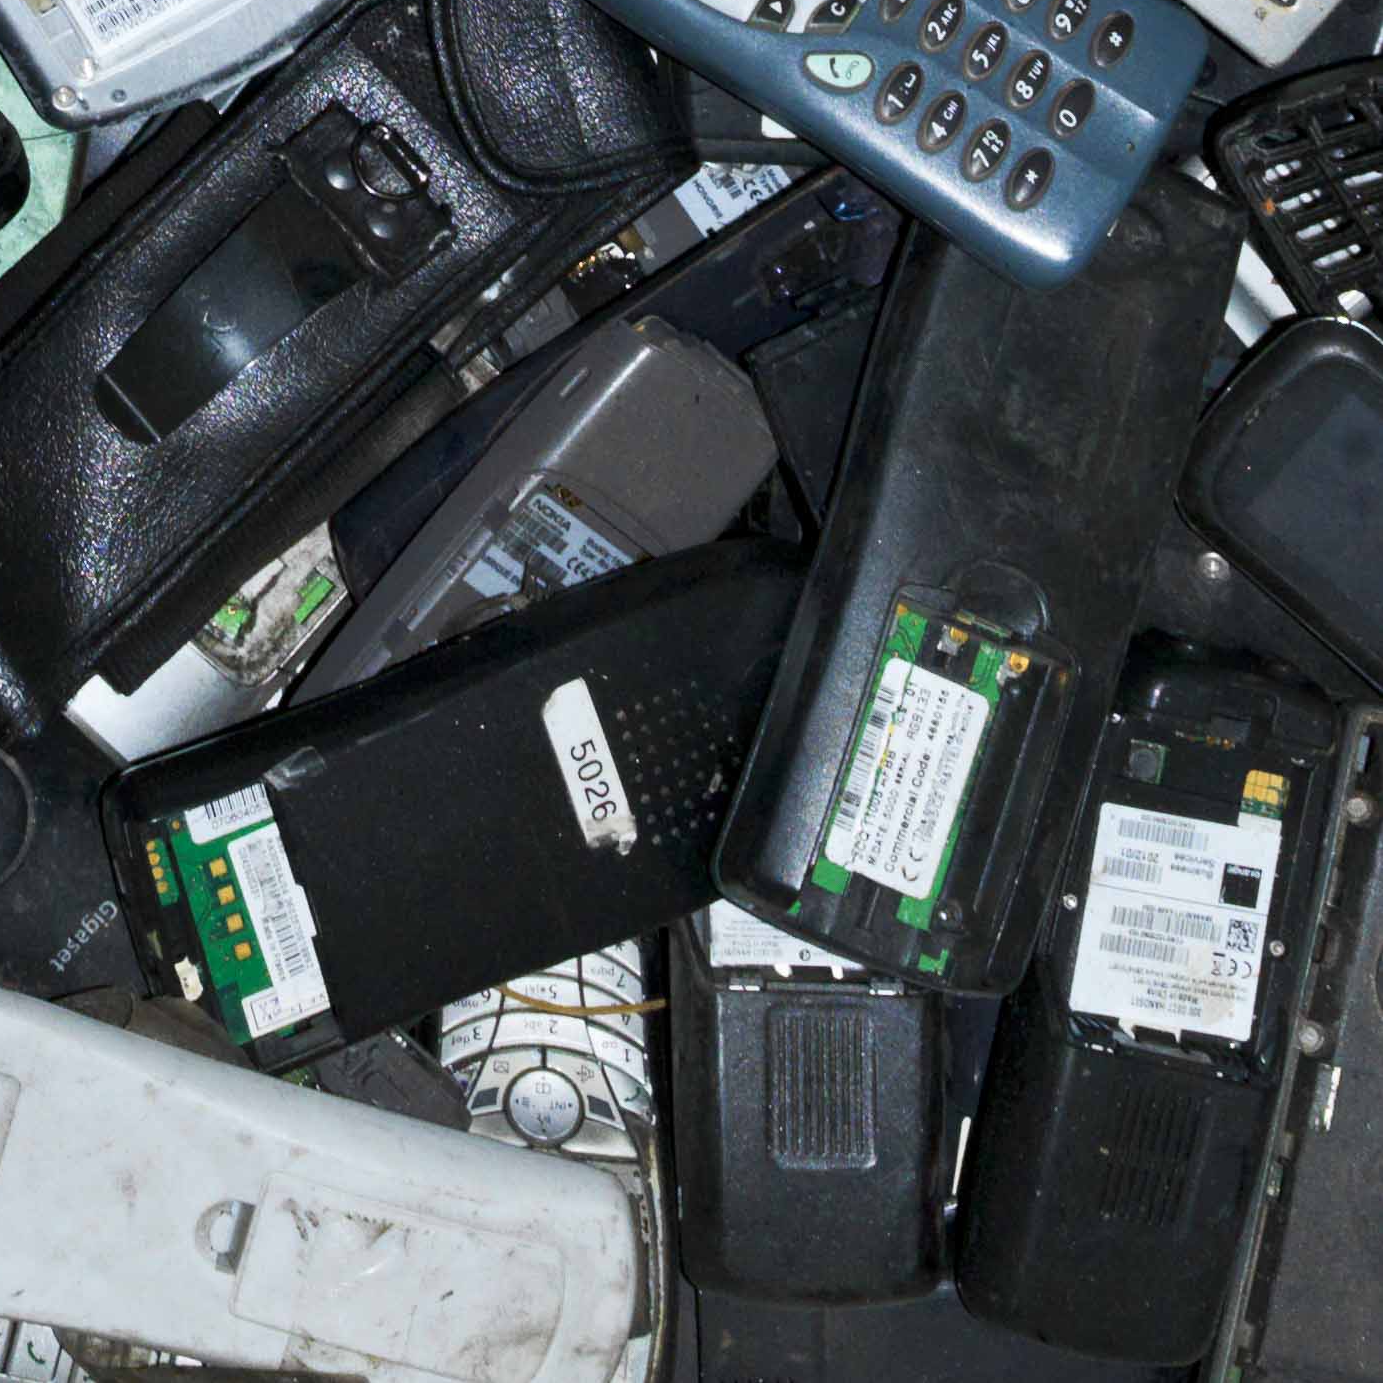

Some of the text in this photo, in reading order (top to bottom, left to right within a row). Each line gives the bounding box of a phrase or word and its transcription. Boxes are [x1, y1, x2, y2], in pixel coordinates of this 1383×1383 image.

[830, 0, 846, 17] C
[1058, 109, 1077, 127] 0
[568, 736, 619, 821] 5026
[879, 746, 935, 875] Commercial Code:
[48, 898, 119, 973] Gigaset
